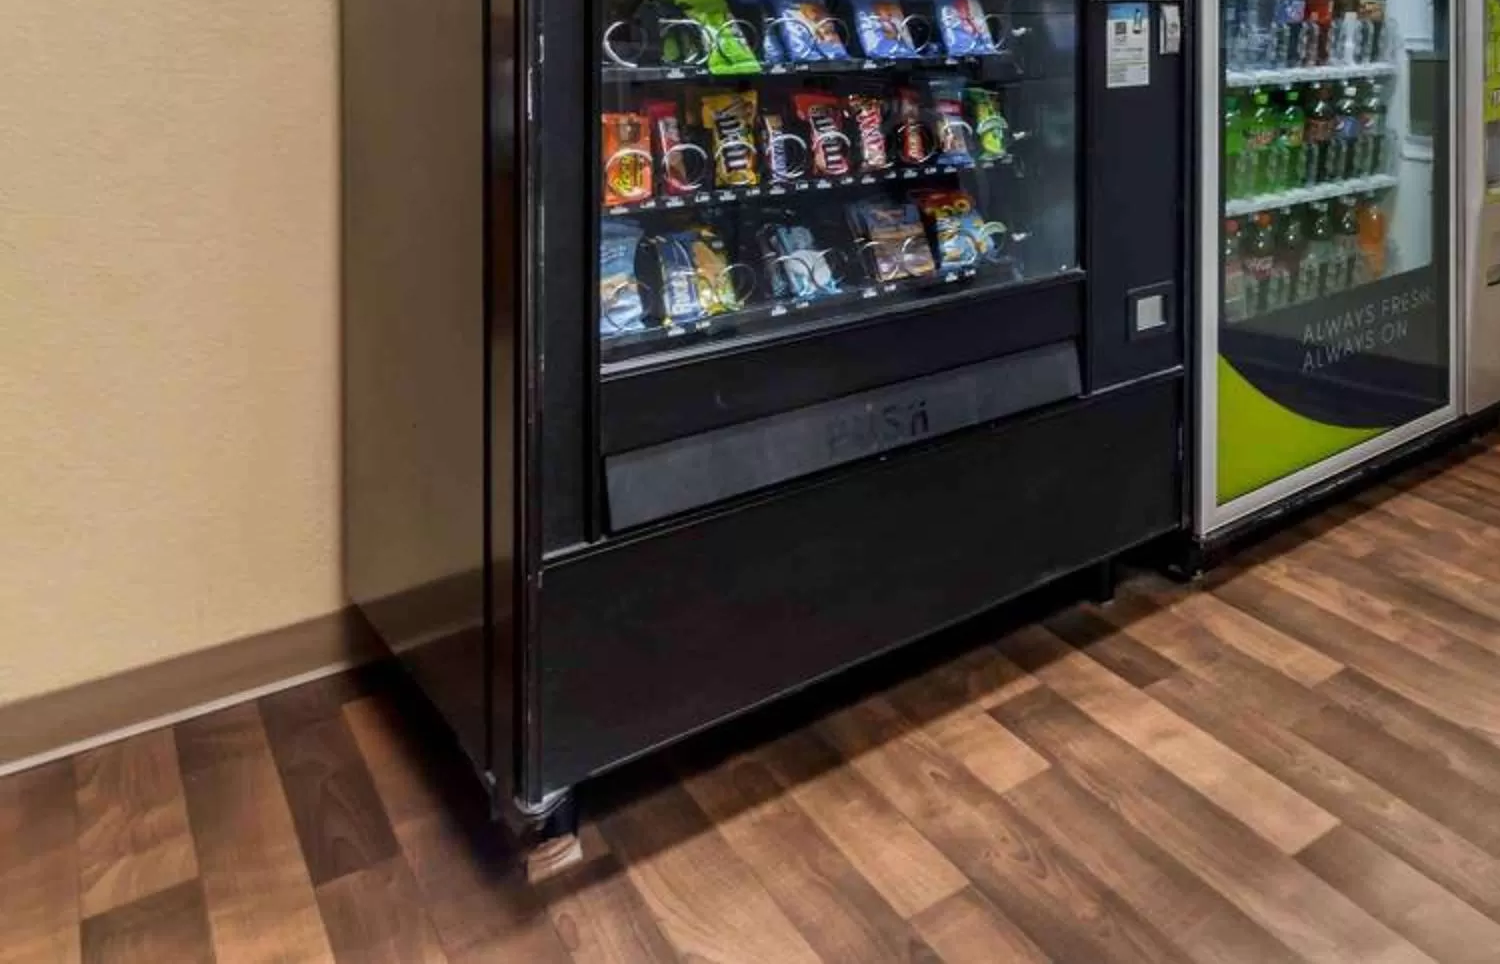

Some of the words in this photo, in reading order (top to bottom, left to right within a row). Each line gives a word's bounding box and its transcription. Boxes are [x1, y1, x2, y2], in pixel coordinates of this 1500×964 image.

[1302, 303, 1376, 345] ALWAYS
[1380, 286, 1435, 317] FRESH
[1302, 328, 1376, 374] ALWAYS
[1380, 319, 1409, 345] ON
